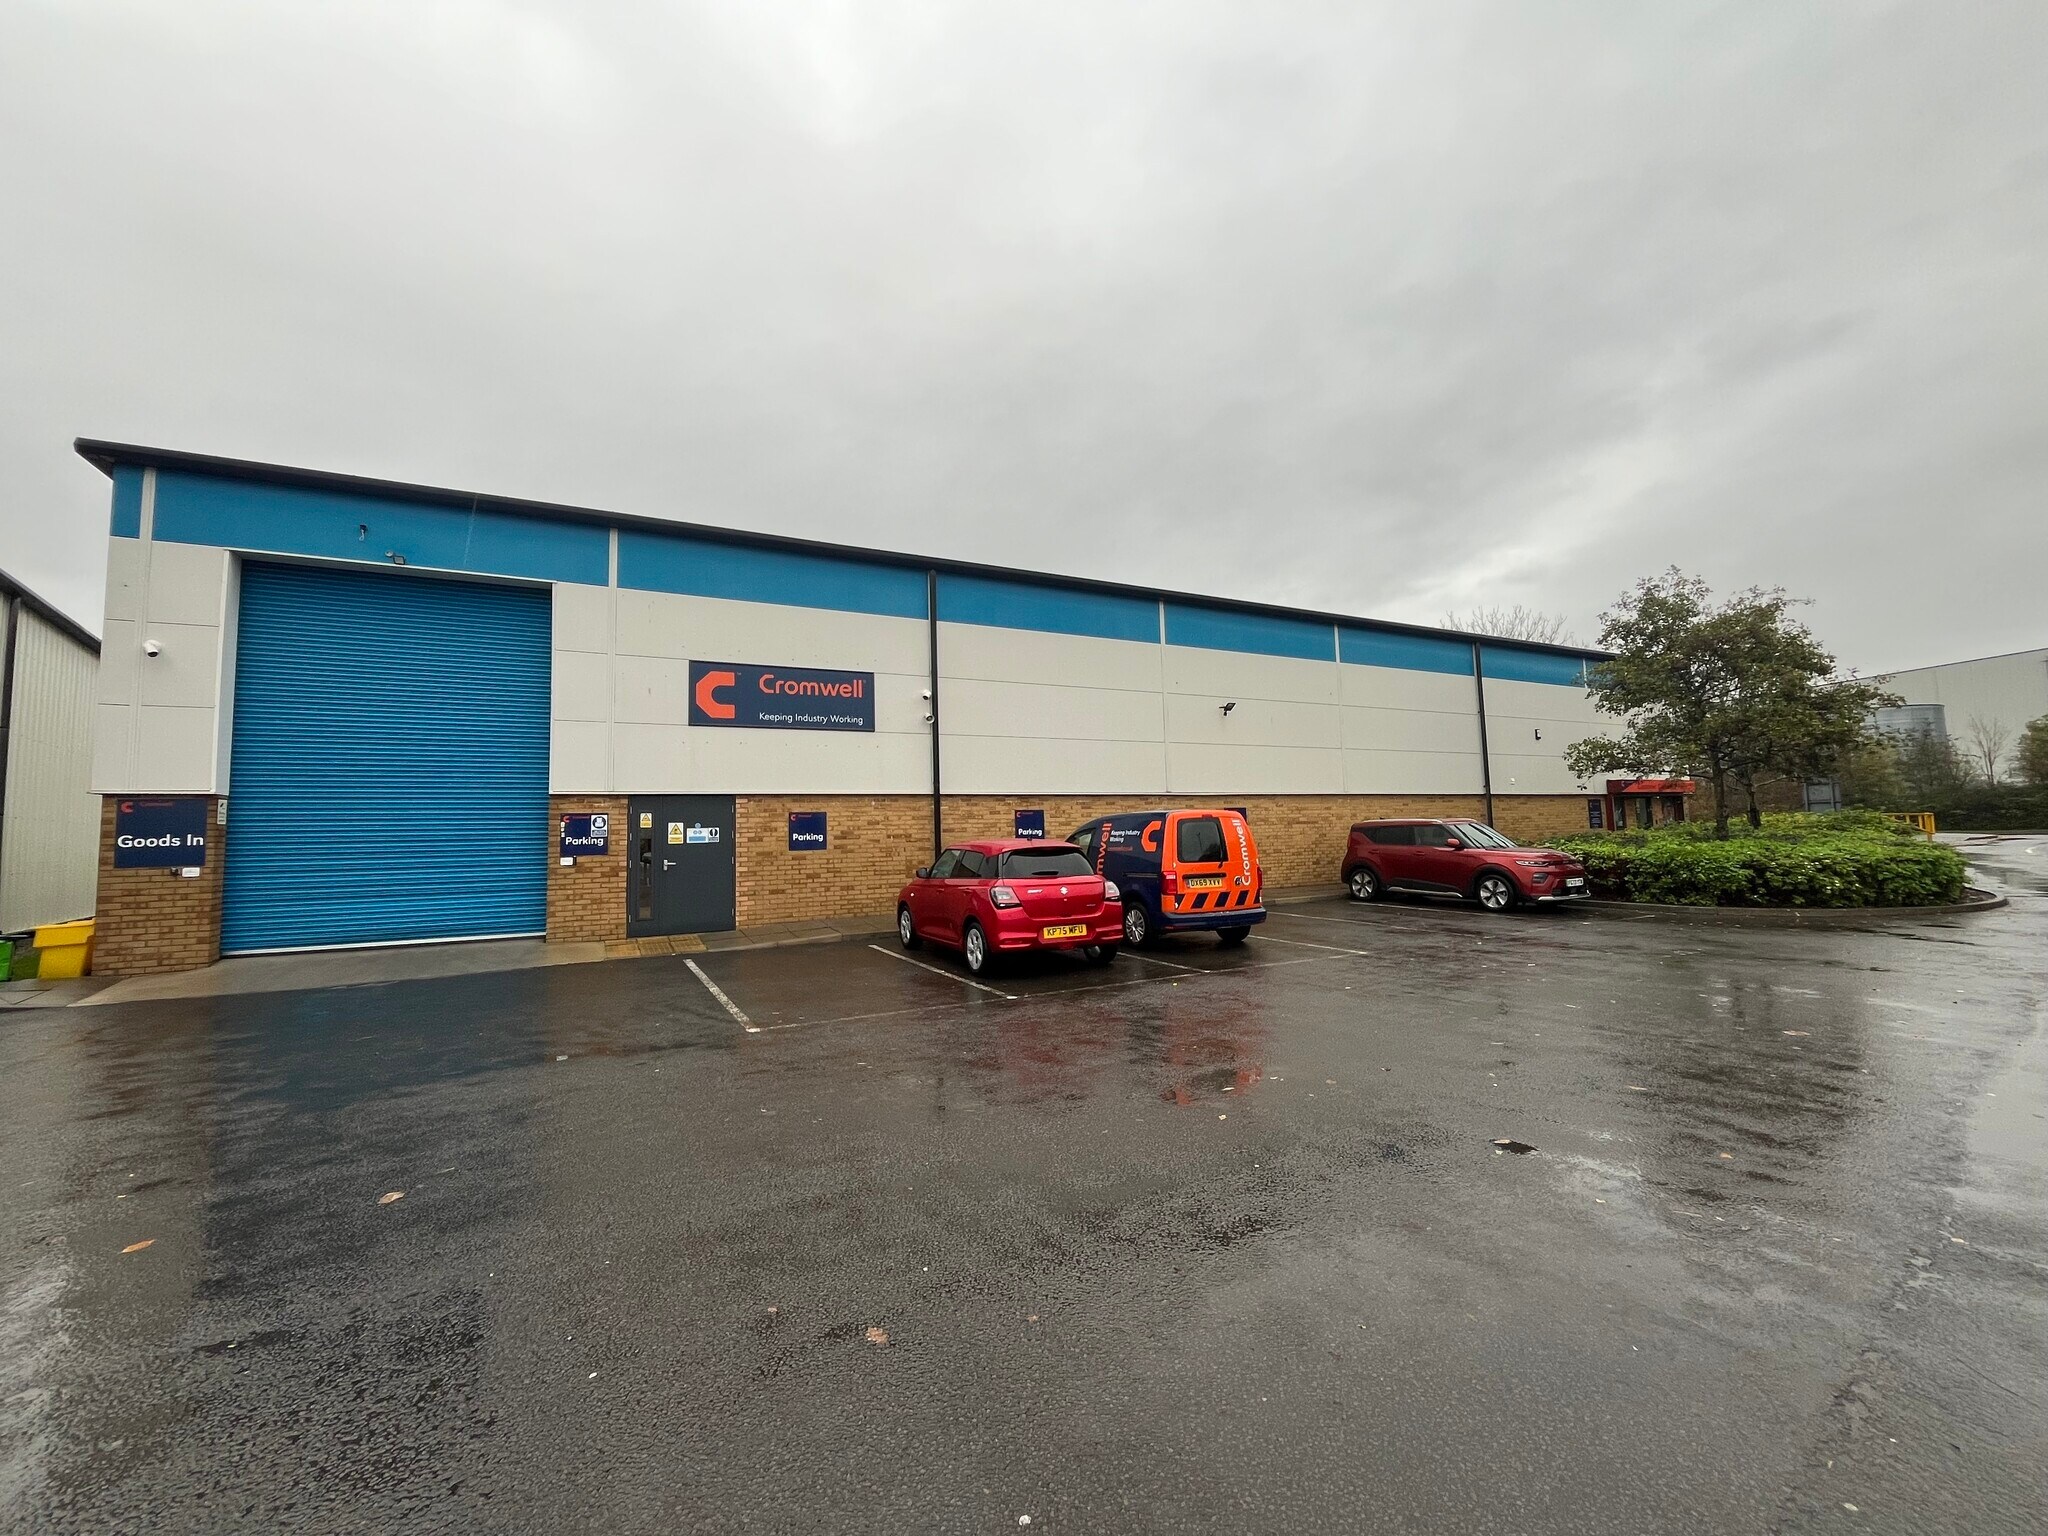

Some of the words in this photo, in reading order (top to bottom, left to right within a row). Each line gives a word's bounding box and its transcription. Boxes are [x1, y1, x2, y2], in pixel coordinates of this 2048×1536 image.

[759, 674, 863, 698] Cromwell
[759, 712, 793, 723] Keeping
[795, 713, 828, 725] Industry
[830, 715, 863, 725] Working
[792, 833, 824, 842] Parking
[1018, 828, 1043, 837] Parking
[117, 833, 181, 848] Goods
[186, 833, 204, 846] In
[565, 836, 604, 847] Parking
[1231, 819, 1251, 886] Cromwell
[1046, 926, 1067, 936] KP75
